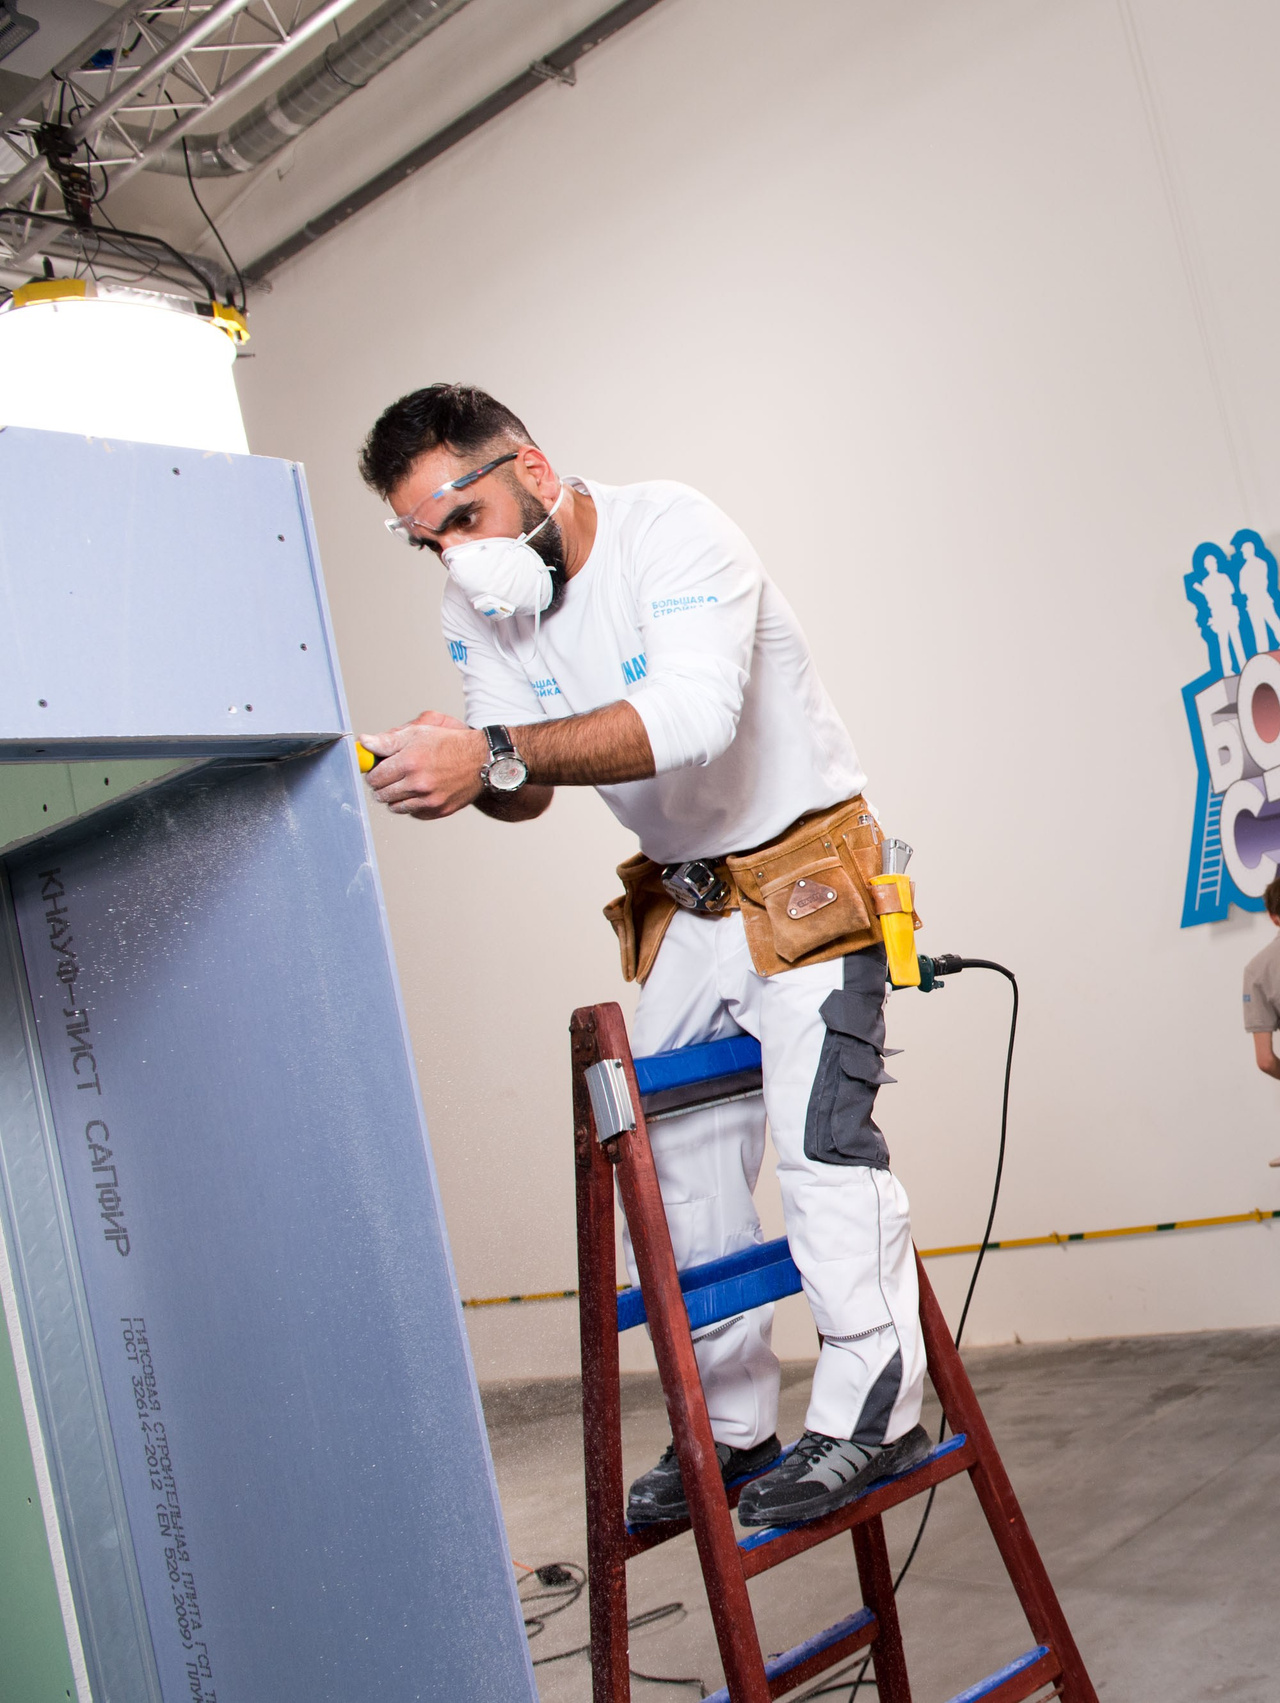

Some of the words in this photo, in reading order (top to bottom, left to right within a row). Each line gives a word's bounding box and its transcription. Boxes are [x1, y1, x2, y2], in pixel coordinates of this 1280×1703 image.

[651, 596, 704, 610] БОЛЬШАЯ
[38, 867, 102, 1096] КНАУФ-ЛИСТ
[85, 1119, 131, 1257] САПФИР
[120, 1318, 139, 1364] ГОСТ
[132, 1375, 163, 1491] 32614-2012
[133, 1318, 161, 1411] ГИПСОВАЯ
[154, 1422, 190, 1562] СТРОИТЕЛЬНАЯ
[182, 1571, 203, 1631] ПЛИТА
[195, 1640, 212, 1678] ГСП
